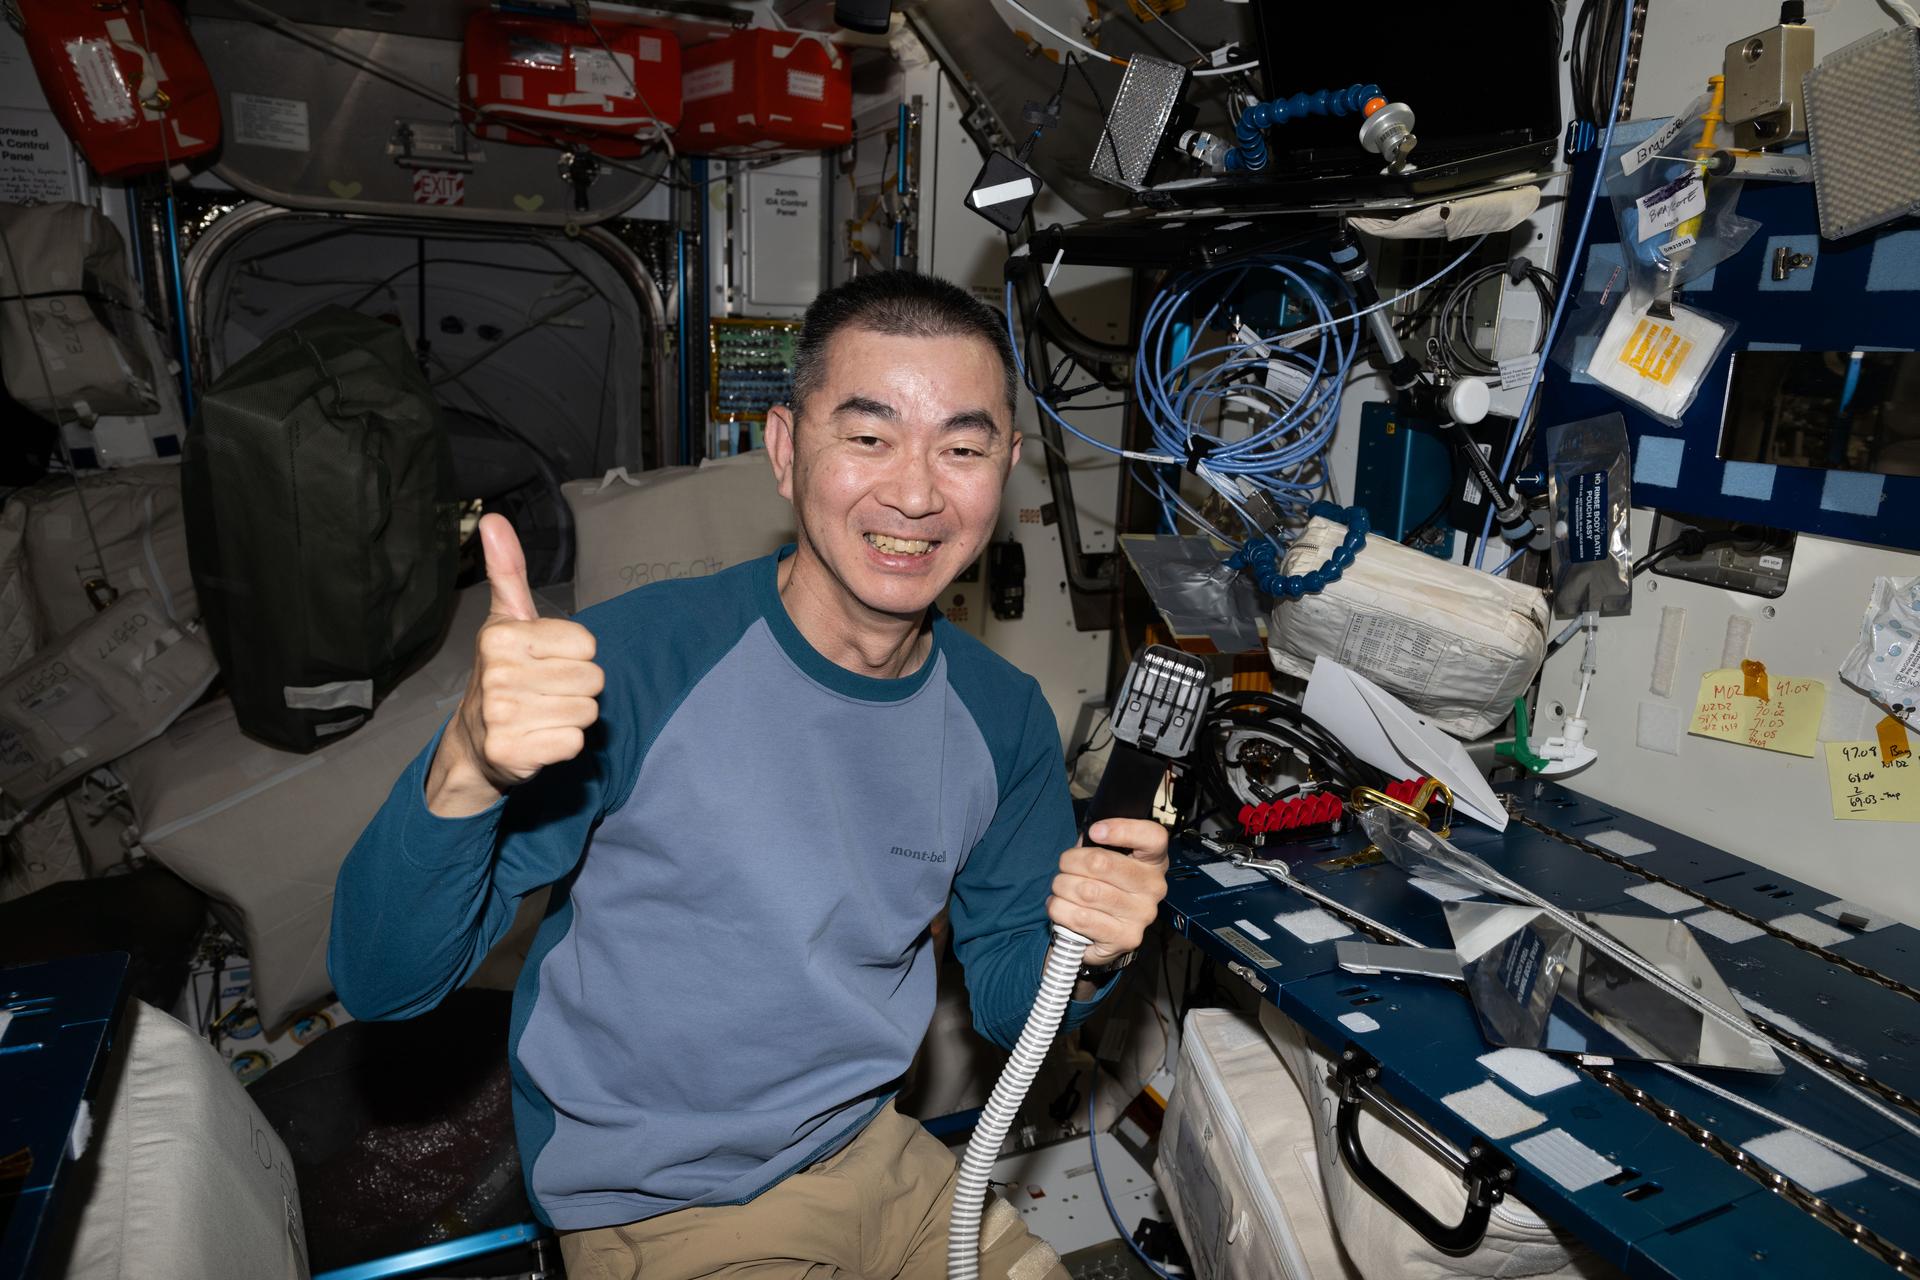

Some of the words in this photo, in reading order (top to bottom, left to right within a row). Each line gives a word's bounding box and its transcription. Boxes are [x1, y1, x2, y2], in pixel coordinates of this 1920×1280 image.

[6, 139, 49, 150] Control
[2, 151, 34, 161] Panel
[421, 175, 456, 195] EXIT
[775, 188, 798, 196] Zenith
[780, 198, 808, 207] Control
[776, 208, 797, 216] Panel
[1594, 472, 1602, 485] NO
[1593, 486, 1601, 510] RINSE
[1593, 510, 1601, 533] BODY
[1594, 534, 1602, 556] BATH
[1895, 673, 1907, 683] DO
